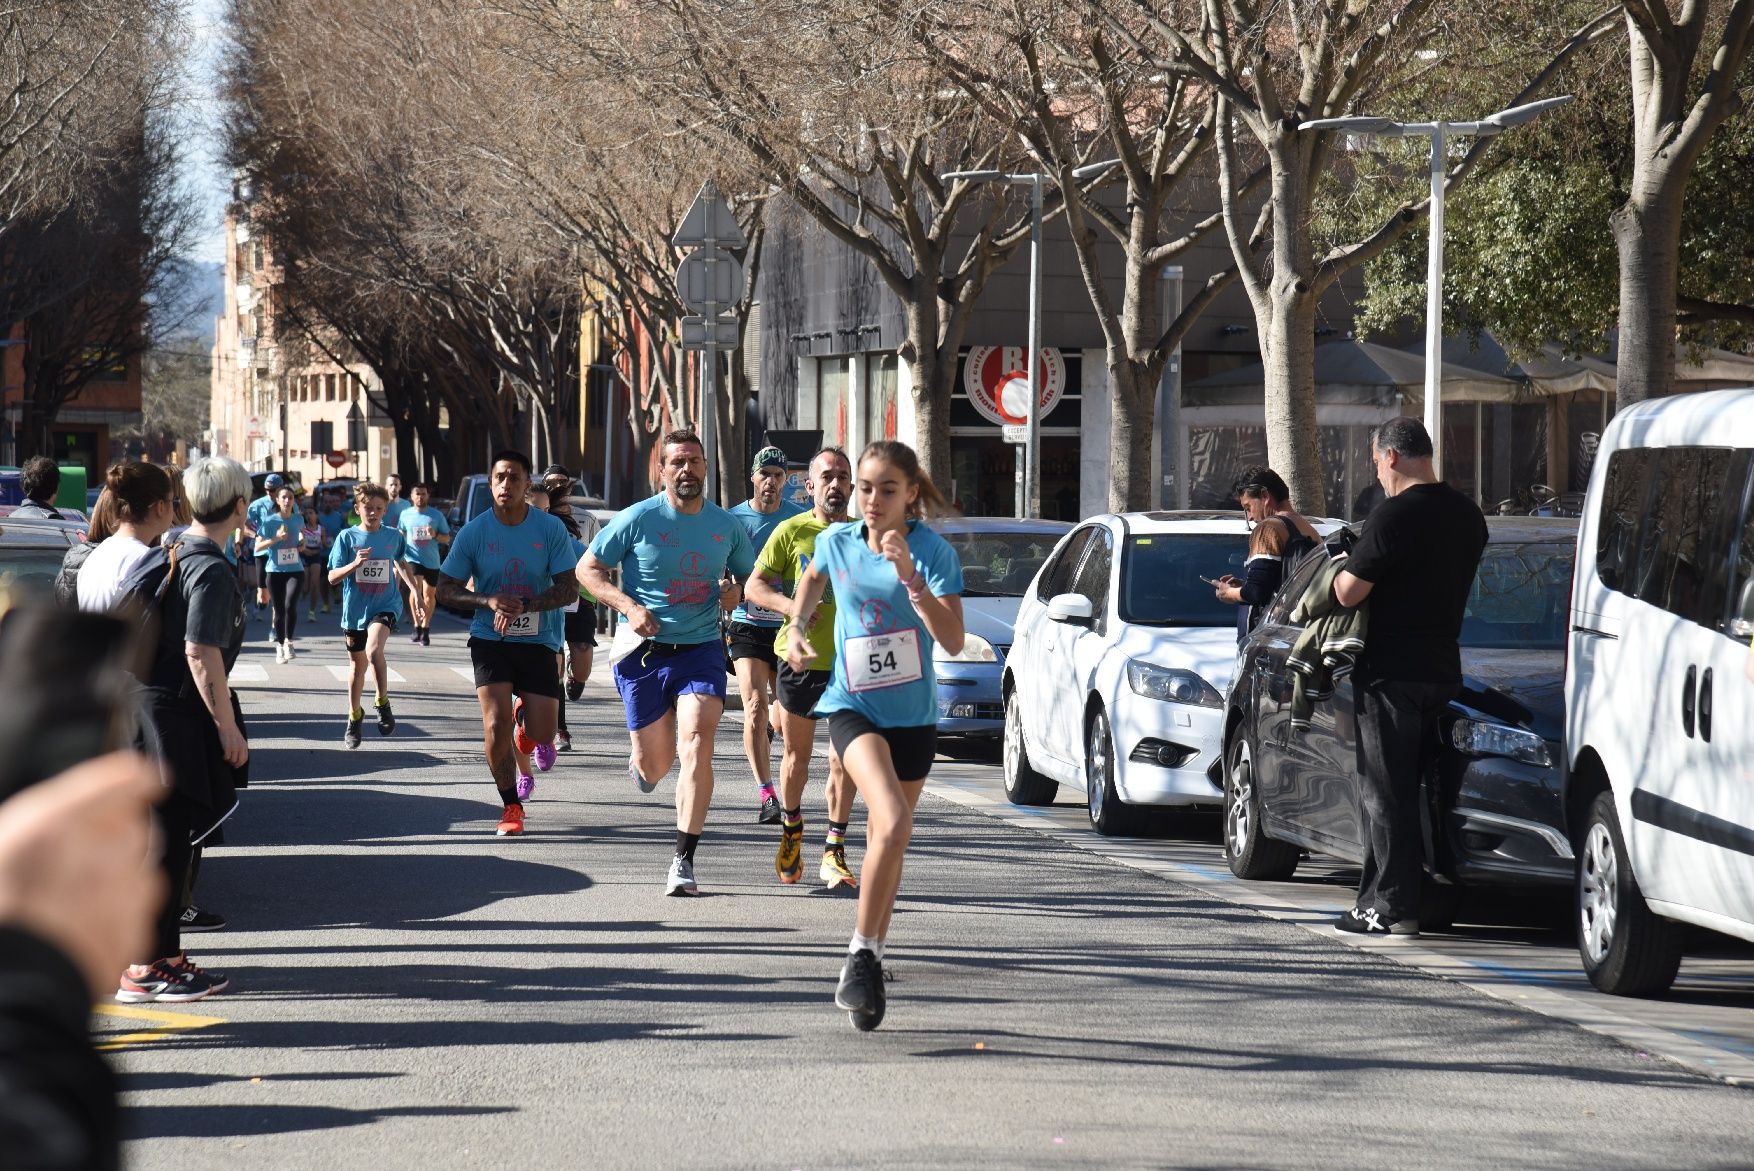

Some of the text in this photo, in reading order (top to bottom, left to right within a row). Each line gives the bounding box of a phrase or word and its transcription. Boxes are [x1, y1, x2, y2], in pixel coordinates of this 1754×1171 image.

[282, 553, 295, 561] 247
[363, 567, 383, 577] 657
[508, 616, 530, 628] 42
[869, 651, 897, 674] 54
